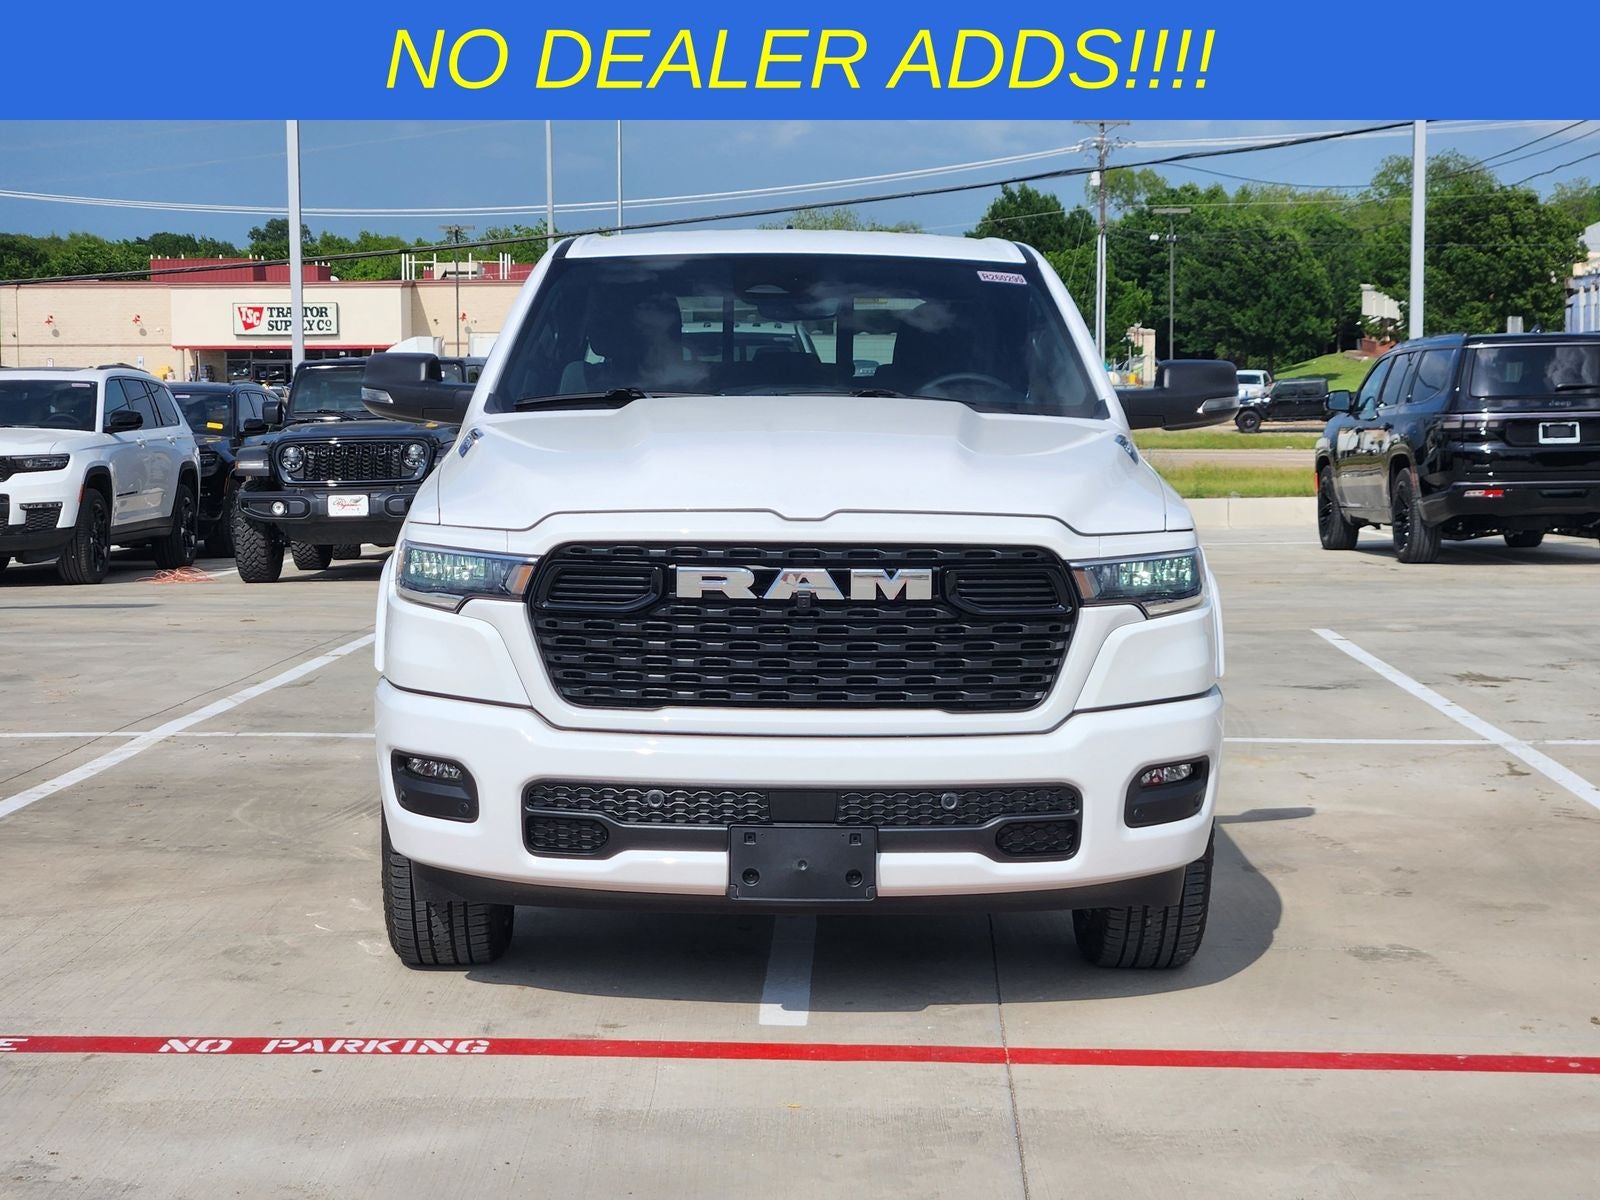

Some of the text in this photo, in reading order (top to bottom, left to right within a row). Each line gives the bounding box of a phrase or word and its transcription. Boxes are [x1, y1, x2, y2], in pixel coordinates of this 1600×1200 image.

[240, 307, 260, 326] TSC
[267, 306, 329, 318] TRATOR
[676, 566, 932, 600] RAM
[158, 1039, 233, 1053] NO
[261, 1039, 490, 1053] PARKING
